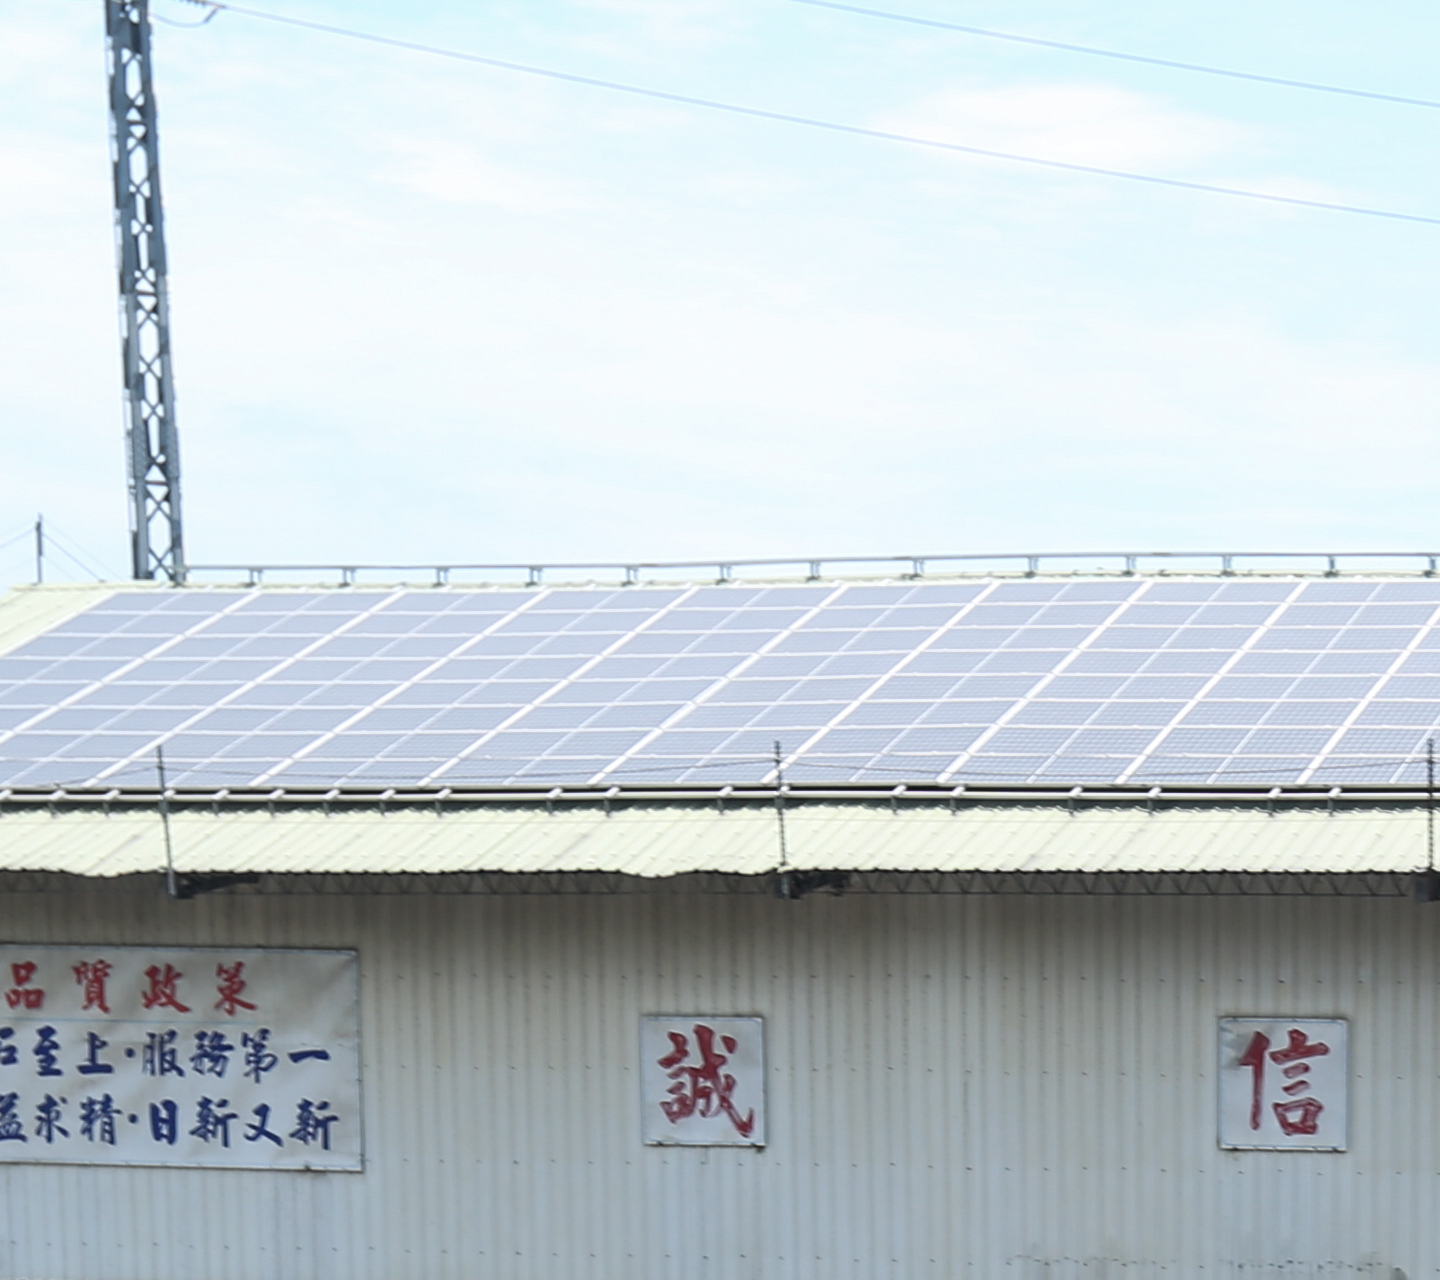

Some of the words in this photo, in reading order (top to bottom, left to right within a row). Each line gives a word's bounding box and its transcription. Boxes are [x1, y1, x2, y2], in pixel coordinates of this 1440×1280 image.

[4, 960, 257, 1015] 品質政策
[658, 1025, 753, 1136] 誠
[1240, 1029, 1329, 1136] 信
